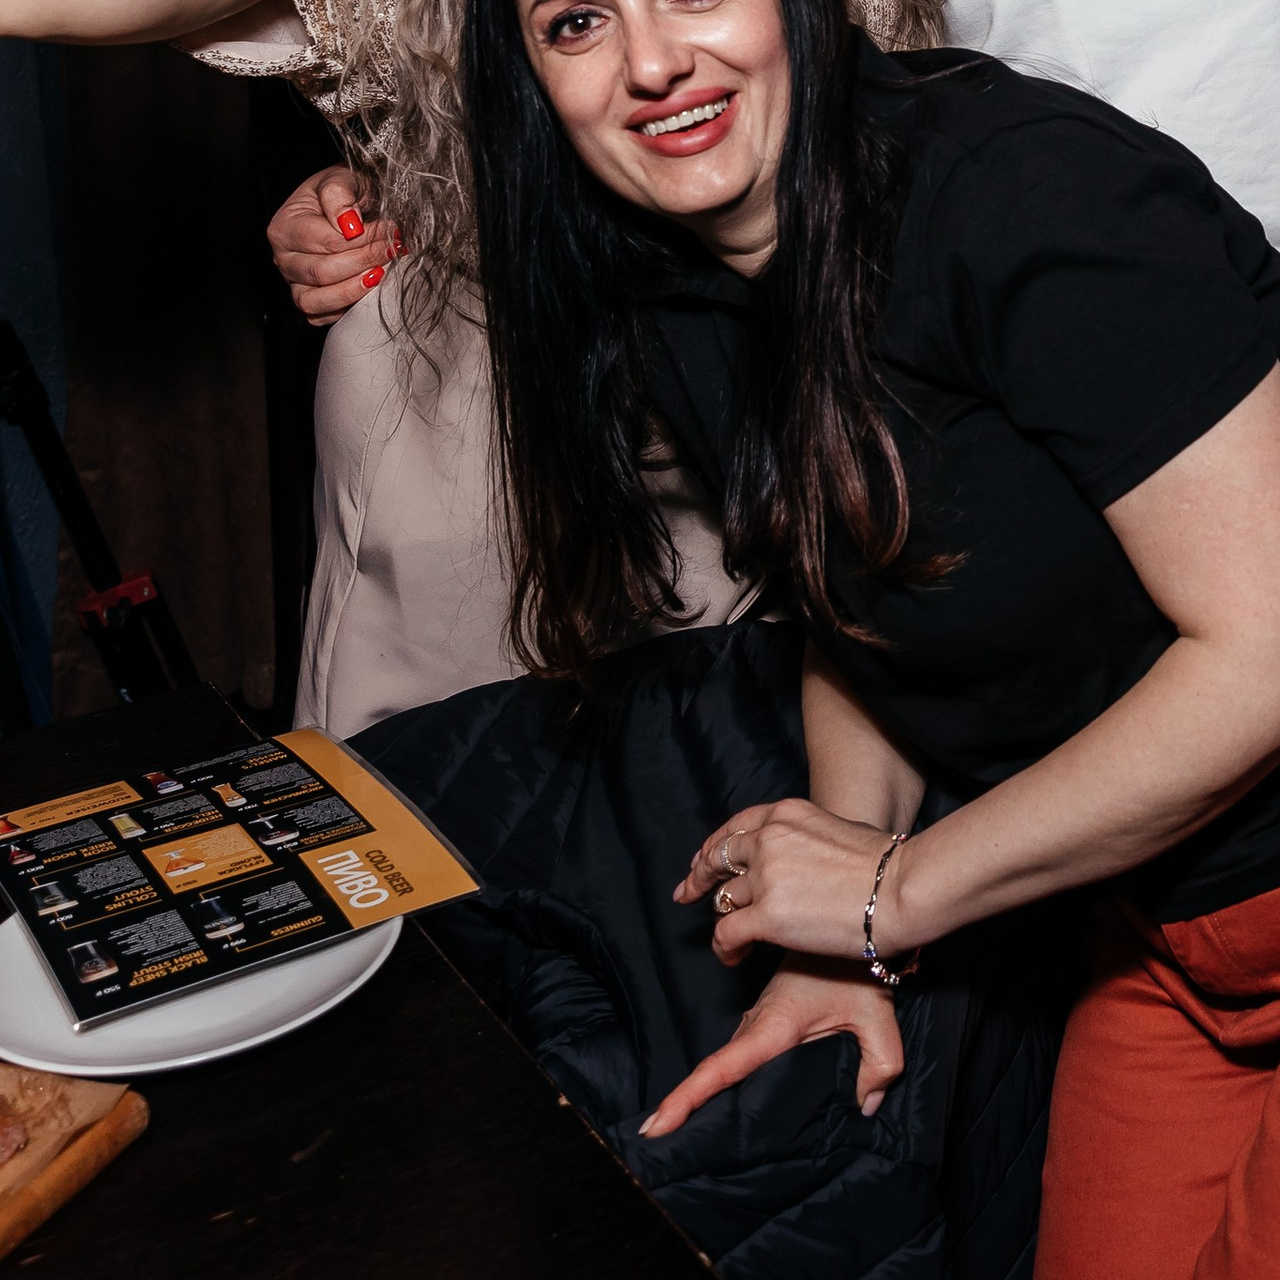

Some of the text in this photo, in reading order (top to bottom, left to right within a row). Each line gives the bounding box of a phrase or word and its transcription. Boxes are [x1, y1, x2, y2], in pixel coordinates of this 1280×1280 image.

[262, 785, 324, 805] KROMBACHER
[65, 795, 132, 816] BUDWEISER
[192, 809, 220, 819] HELL
[164, 813, 223, 833] HEIDEGGER
[42, 840, 114, 864] KRIEK BOON
[83, 844, 117, 858] BOON
[230, 854, 263, 867] BLOND
[217, 858, 266, 876] AFFLIGEM
[365, 849, 415, 897] COLD BEER
[317, 849, 390, 909] ПИВО
[104, 891, 158, 912] COLLINS
[113, 885, 154, 901] STOUT
[270, 915, 323, 937] GUINNESS
[129, 955, 208, 987] BLACK SHEEP
[133, 949, 204, 977] IRISH STOUT
[103, 984, 121, 994] 550
